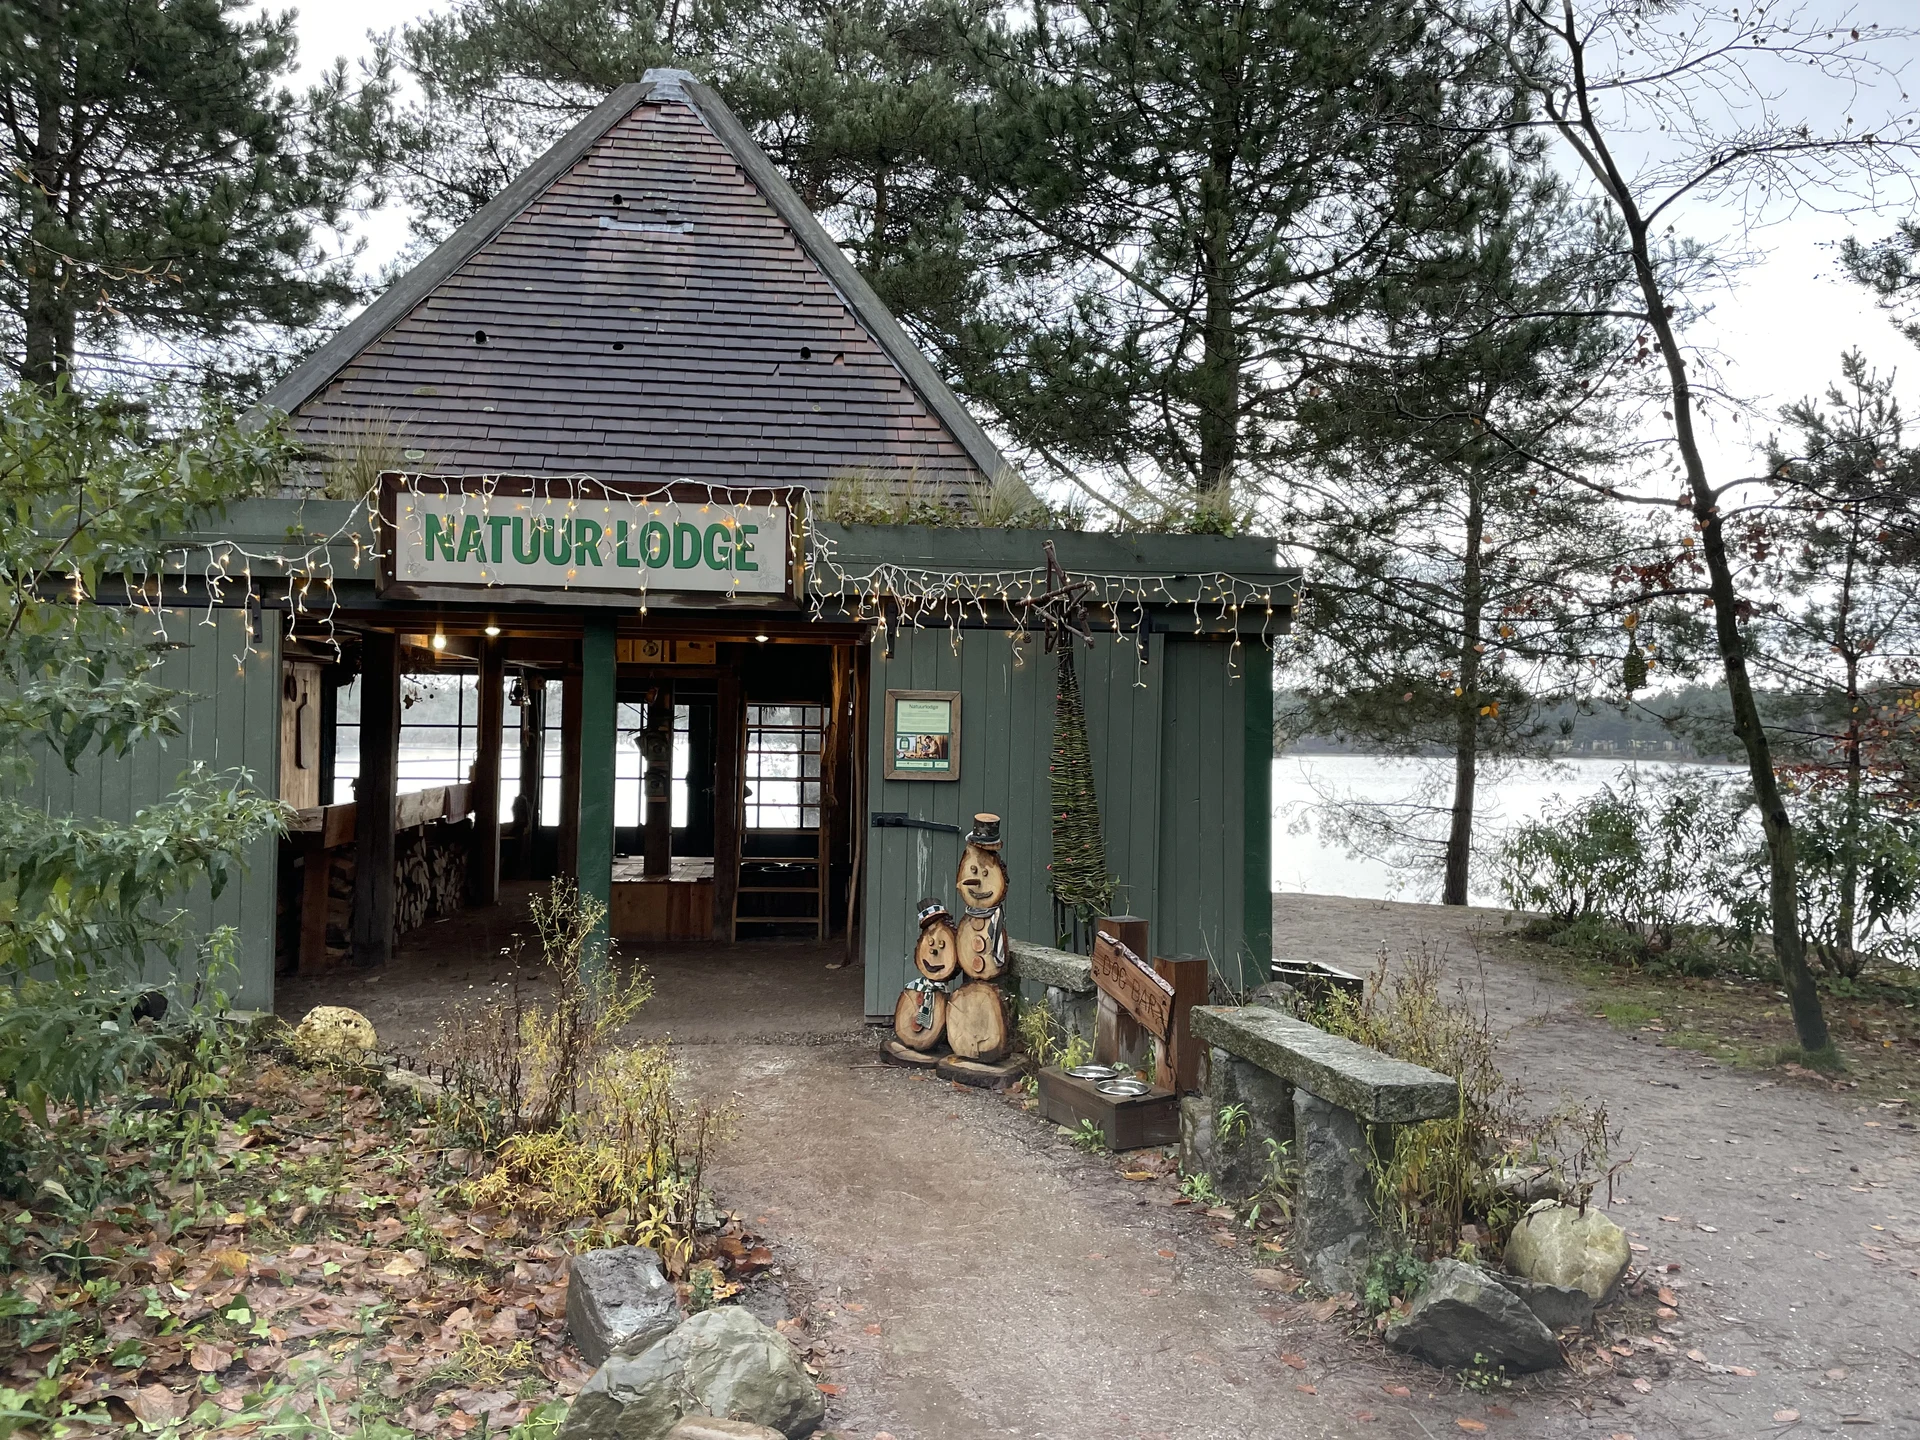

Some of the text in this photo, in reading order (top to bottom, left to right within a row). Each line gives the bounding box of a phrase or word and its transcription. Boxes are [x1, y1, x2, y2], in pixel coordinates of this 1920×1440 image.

[425, 513, 759, 571] NATUUR LODGE
[1102, 954, 1158, 1018] DOG BAR
